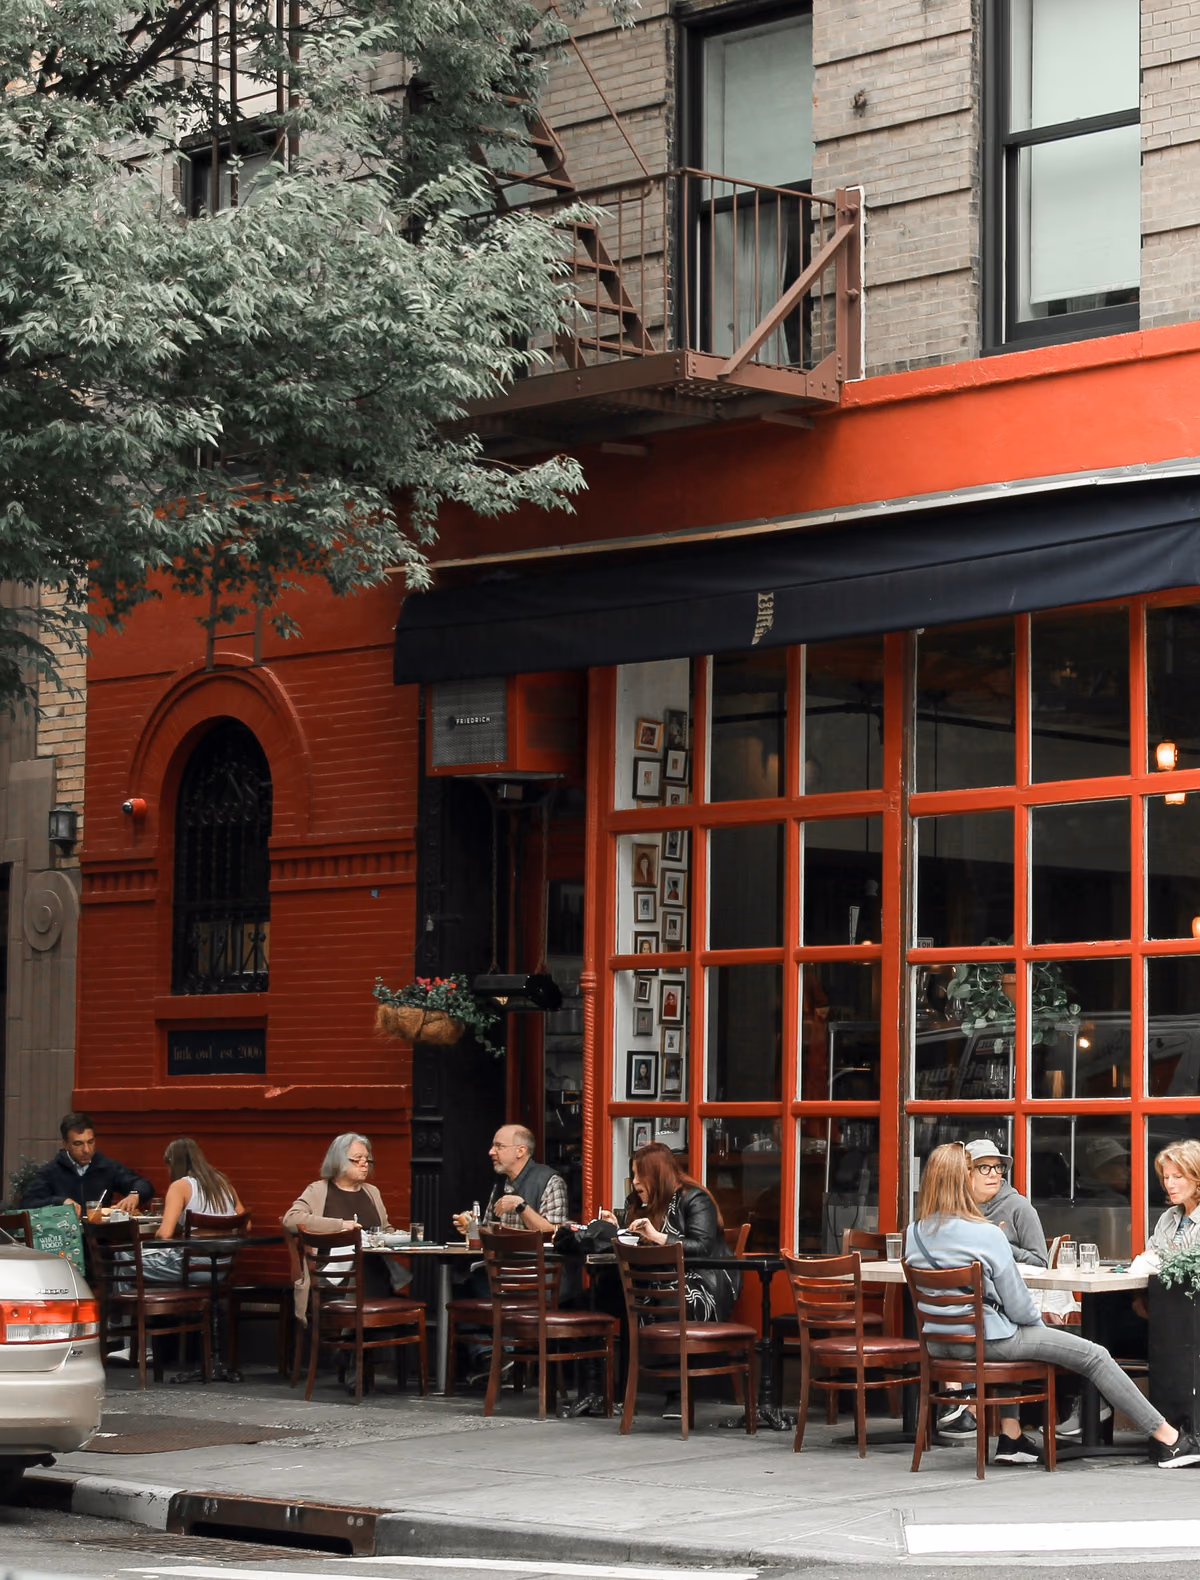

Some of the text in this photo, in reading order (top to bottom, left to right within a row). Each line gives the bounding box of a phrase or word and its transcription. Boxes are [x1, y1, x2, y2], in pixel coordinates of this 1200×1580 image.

[456, 716, 491, 725] FRIEDRICH
[39, 1234, 63, 1245] WHOLE
[41, 1241, 64, 1250] FOODS
